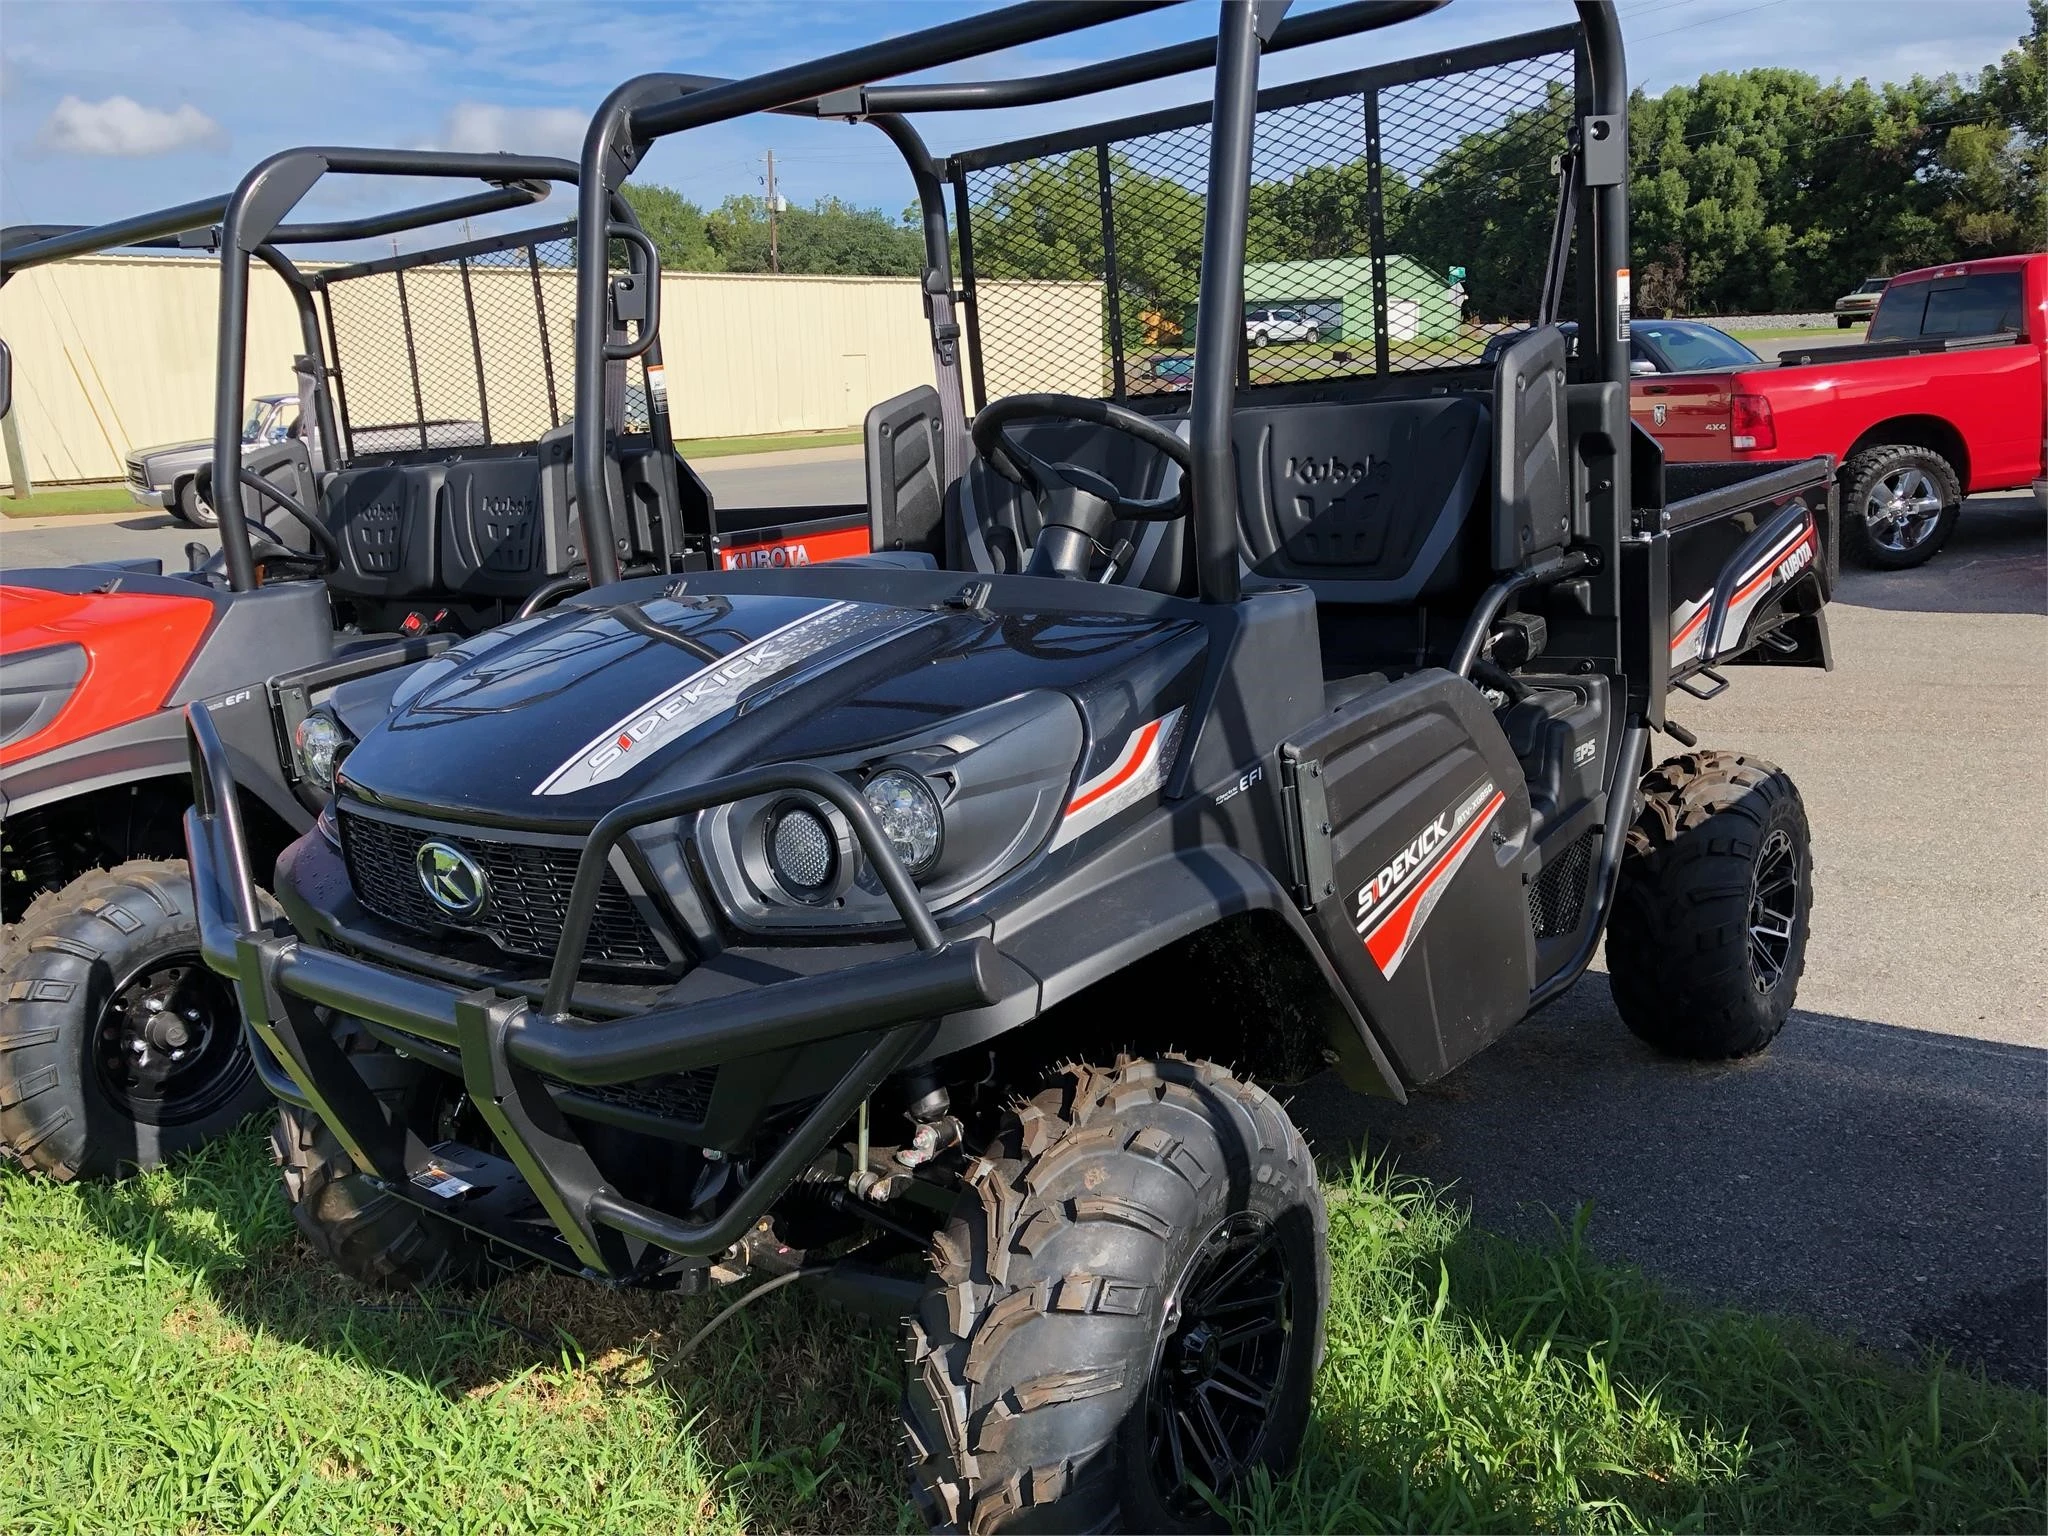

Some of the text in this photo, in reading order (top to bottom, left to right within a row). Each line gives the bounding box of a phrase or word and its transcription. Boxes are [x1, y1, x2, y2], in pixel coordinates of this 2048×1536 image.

[725, 544, 810, 571] KUBOTA
[1779, 540, 1813, 584] KUBOTA
[225, 690, 250, 706] EFI
[588, 642, 781, 782] SIDEKICK
[1573, 738, 1596, 764] EPS
[1239, 766, 1262, 791] EFI
[1356, 812, 1449, 919] SIDEKICK
